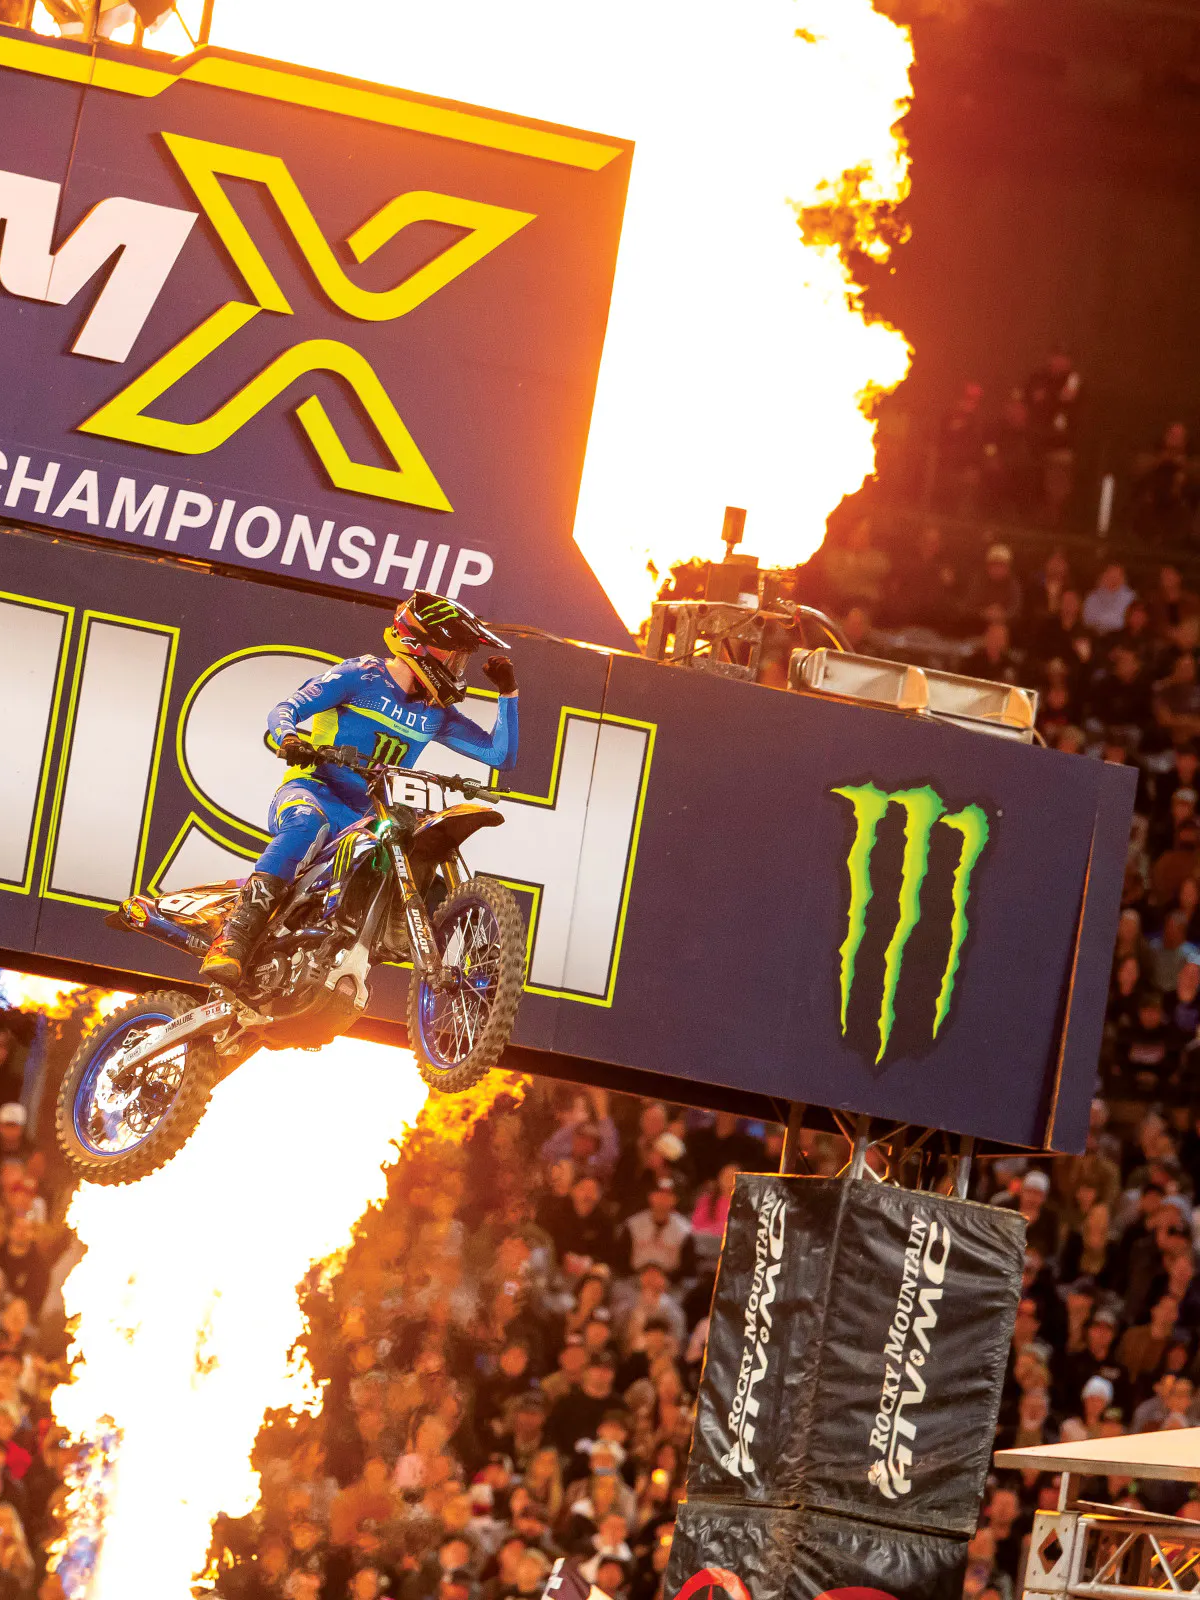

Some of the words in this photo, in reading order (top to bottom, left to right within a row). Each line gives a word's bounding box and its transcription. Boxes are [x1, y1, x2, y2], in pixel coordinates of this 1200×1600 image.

[392, 775, 446, 813] 61
[411, 908, 431, 954] DUNLOP
[728, 1346, 754, 1433] ROCKY
[743, 1189, 778, 1345] MOUNTAIN
[884, 1214, 928, 1364] MOUNTAIN
[869, 1363, 902, 1455] ROCKY
